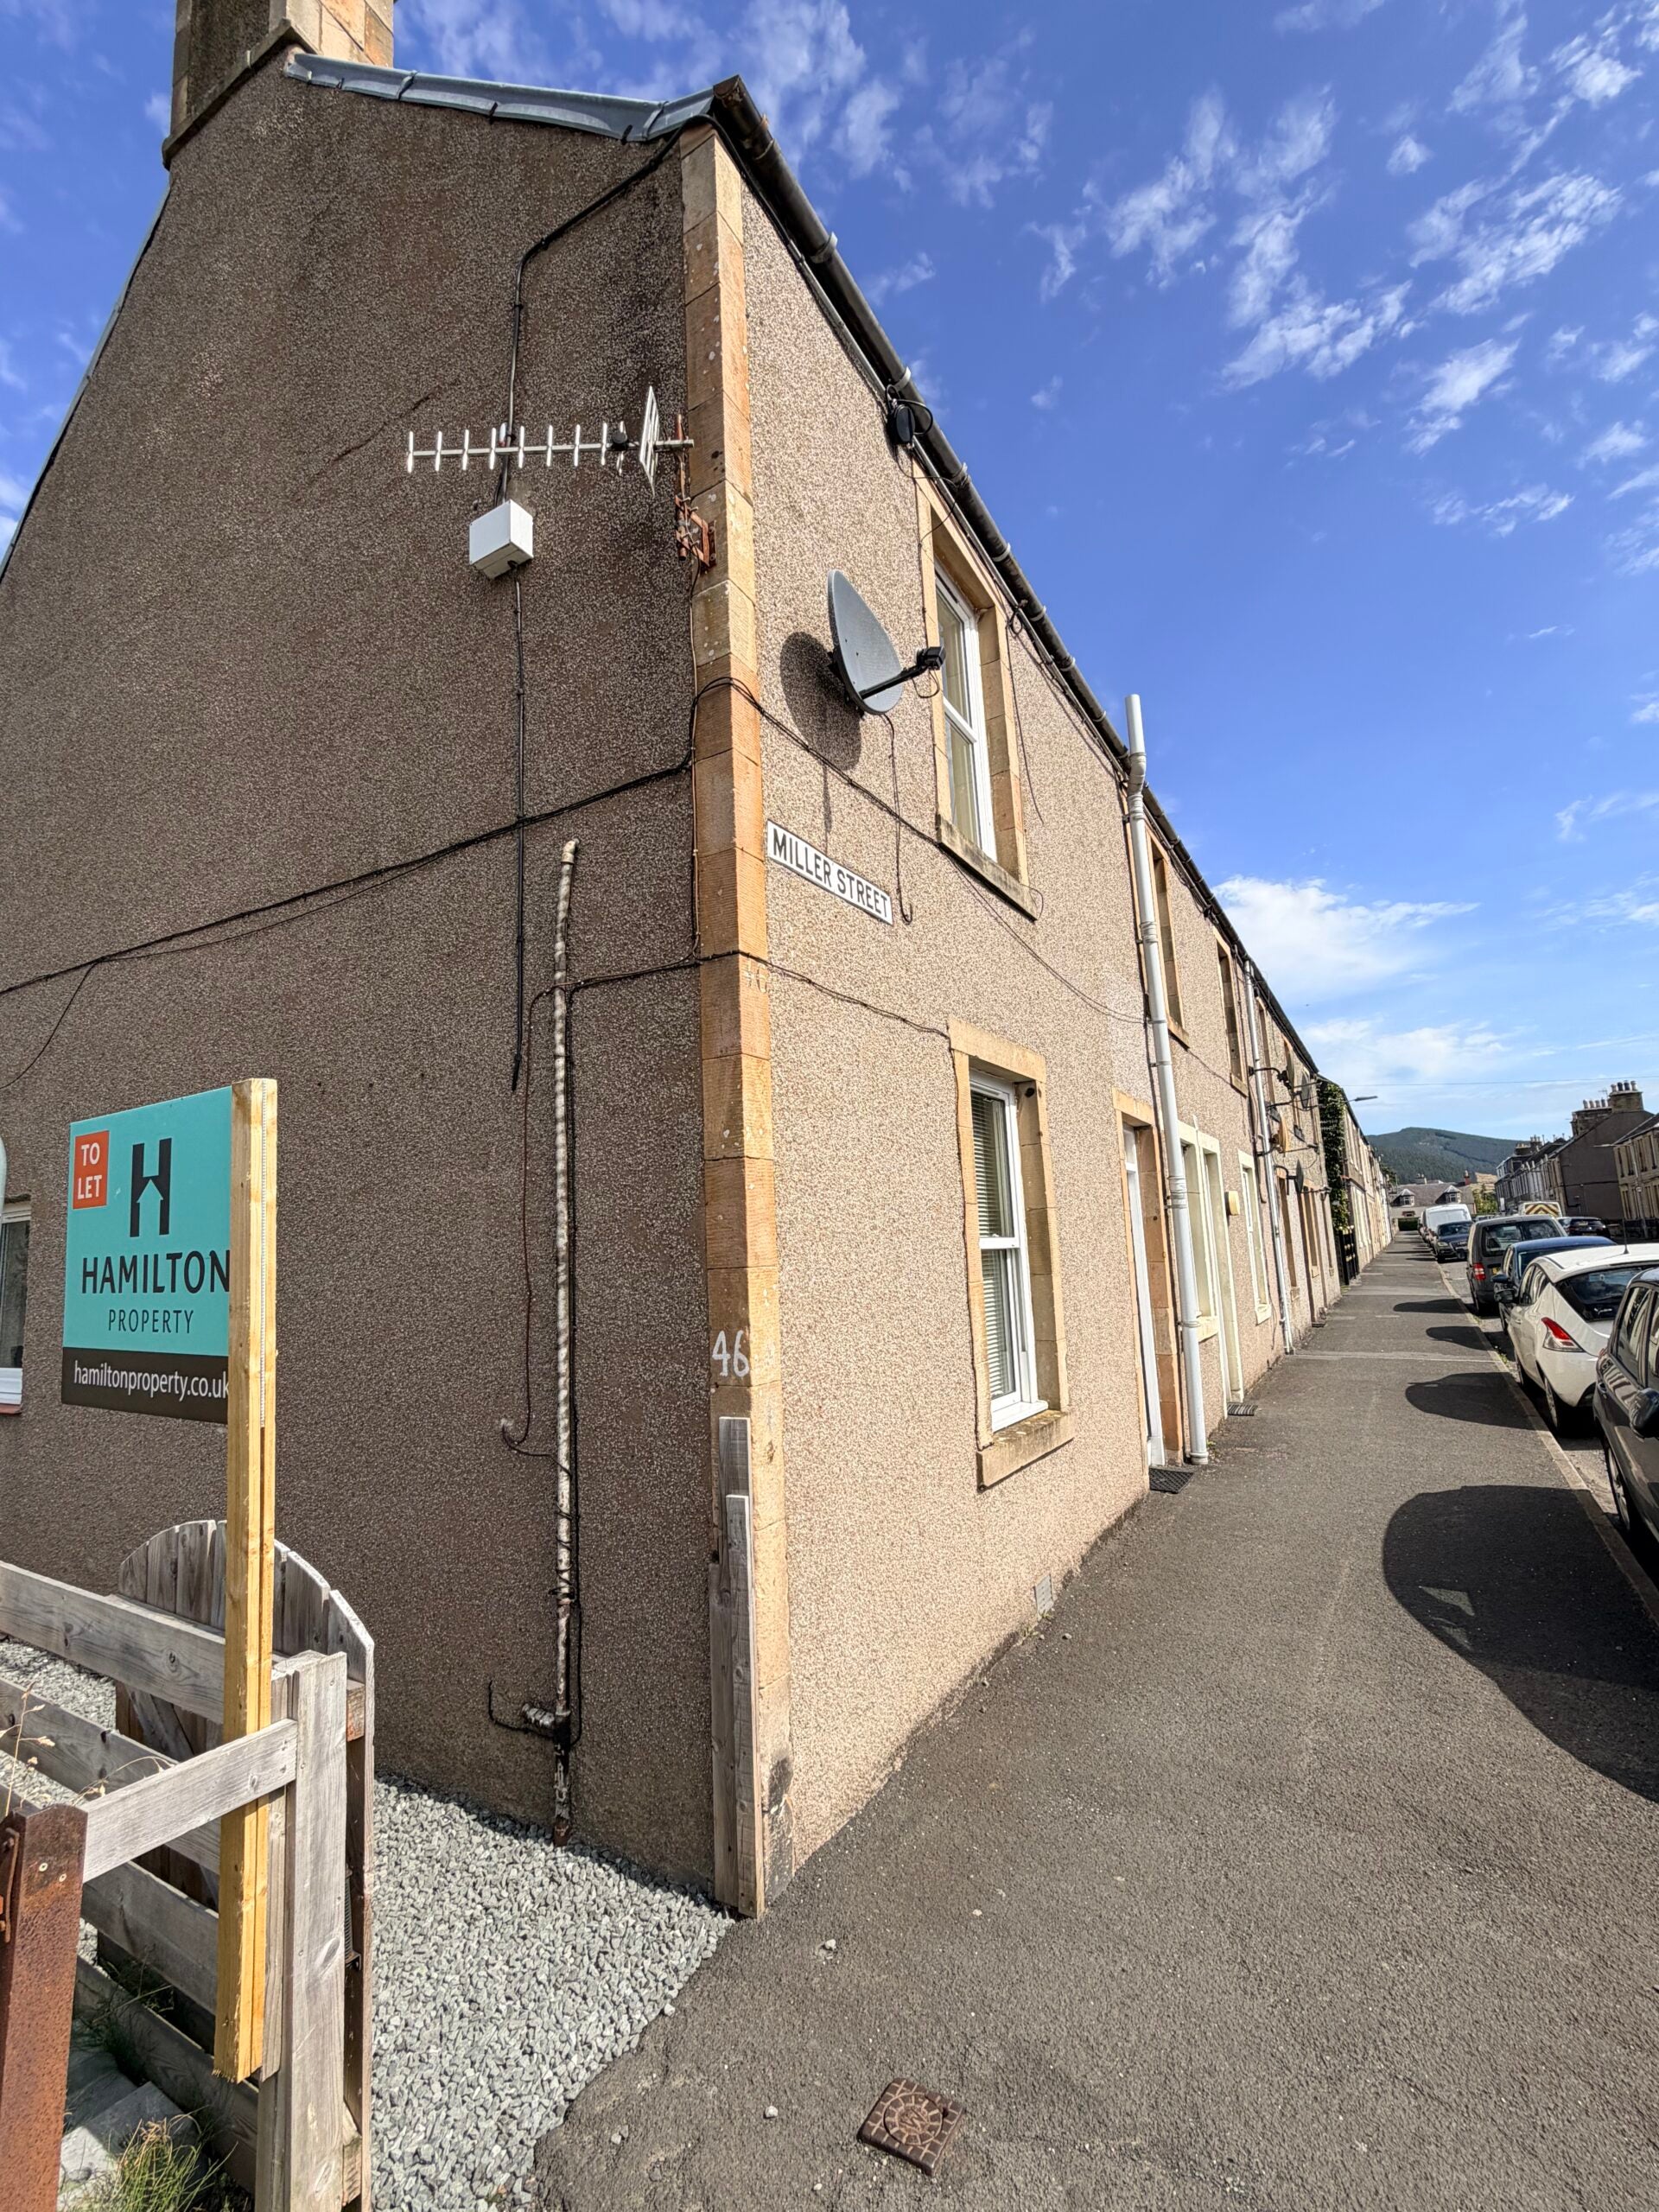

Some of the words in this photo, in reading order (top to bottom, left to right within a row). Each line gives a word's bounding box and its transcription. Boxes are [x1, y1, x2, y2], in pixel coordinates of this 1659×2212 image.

[773, 828, 832, 887] MILLER
[836, 868, 887, 918] STREET
[81, 1142, 99, 1166] TO
[78, 1175, 102, 1200] LET
[82, 1249, 230, 1294] HAMILTON
[108, 1309, 194, 1334] PROPERTY
[712, 1331, 750, 1376] 46
[74, 1361, 229, 1402] hamiltonproperty.co.uk
